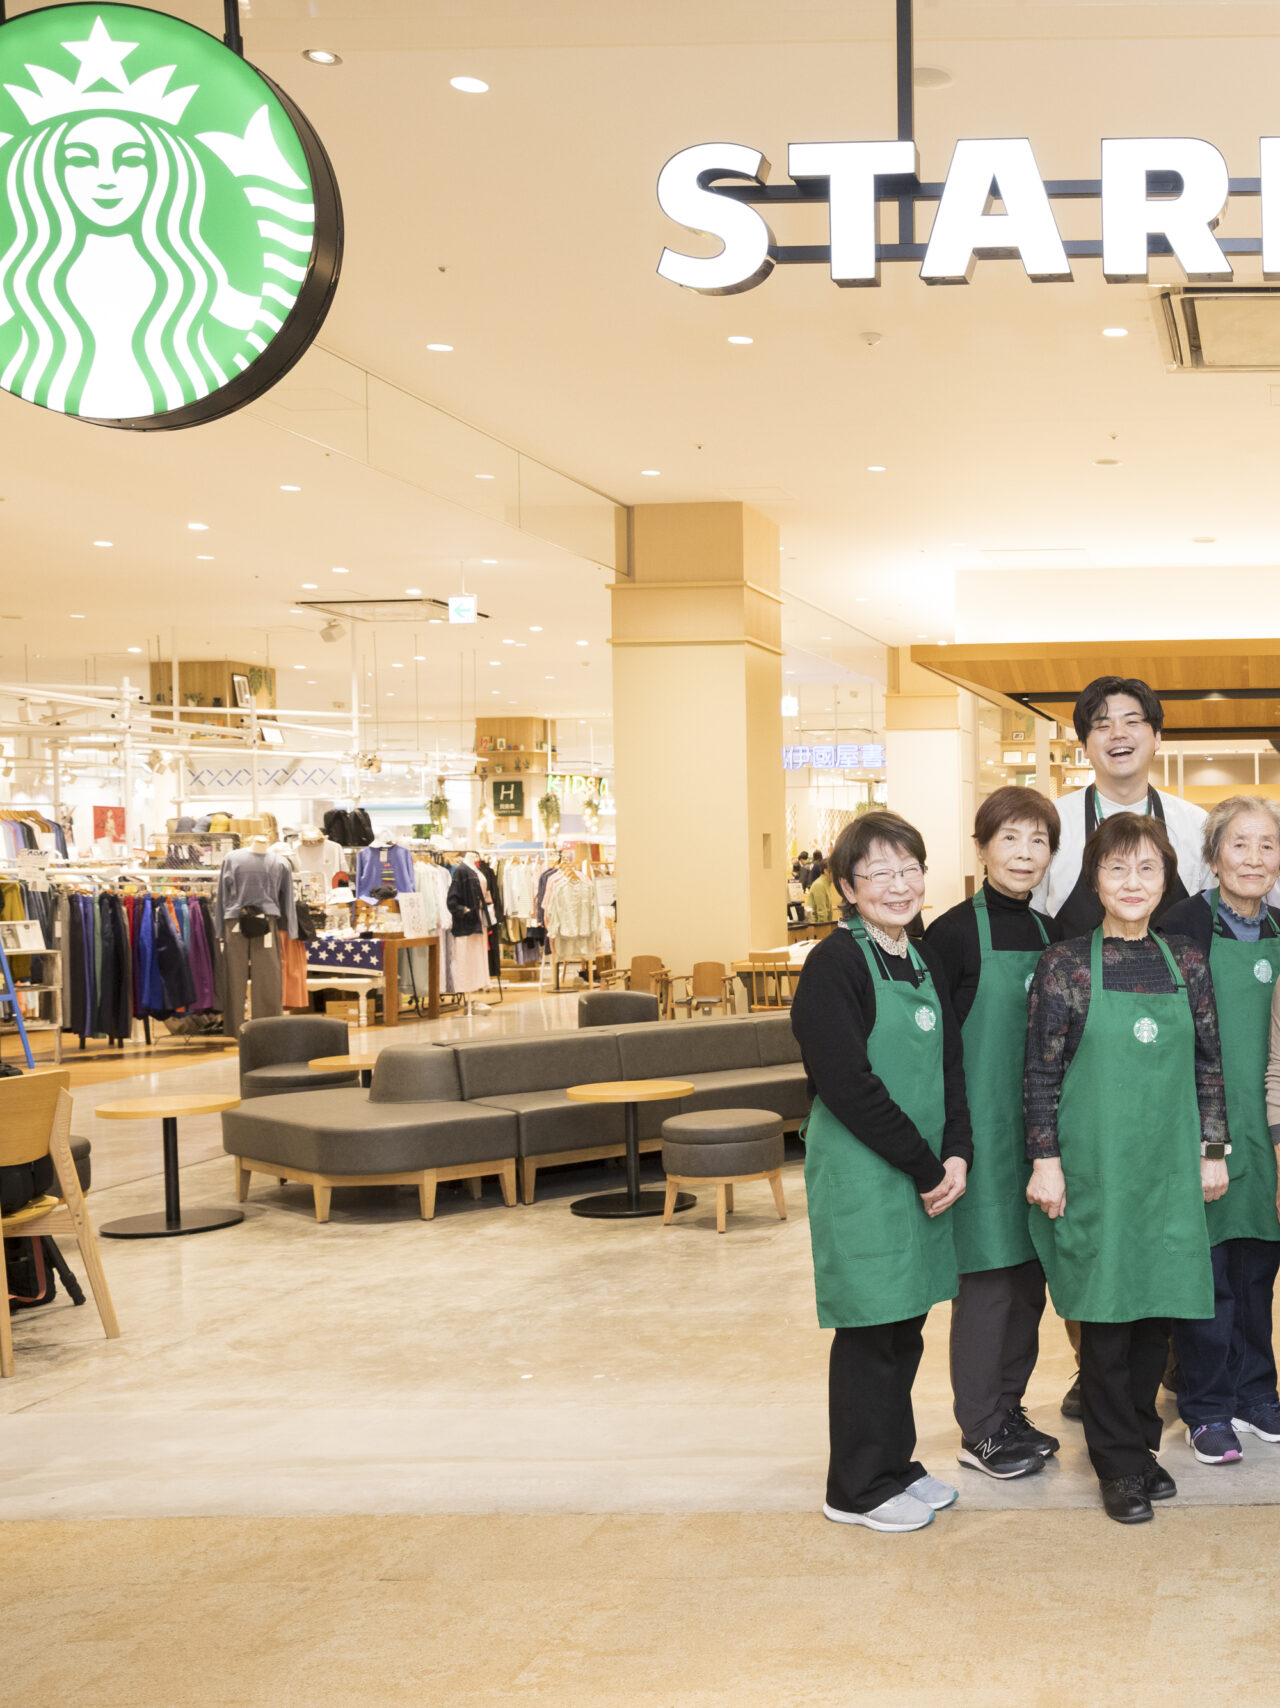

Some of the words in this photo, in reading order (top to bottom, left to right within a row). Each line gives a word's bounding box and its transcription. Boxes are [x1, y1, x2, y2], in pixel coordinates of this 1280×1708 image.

[782, 743, 888, 770] 伊國屋書
[500, 783, 514, 801] H
